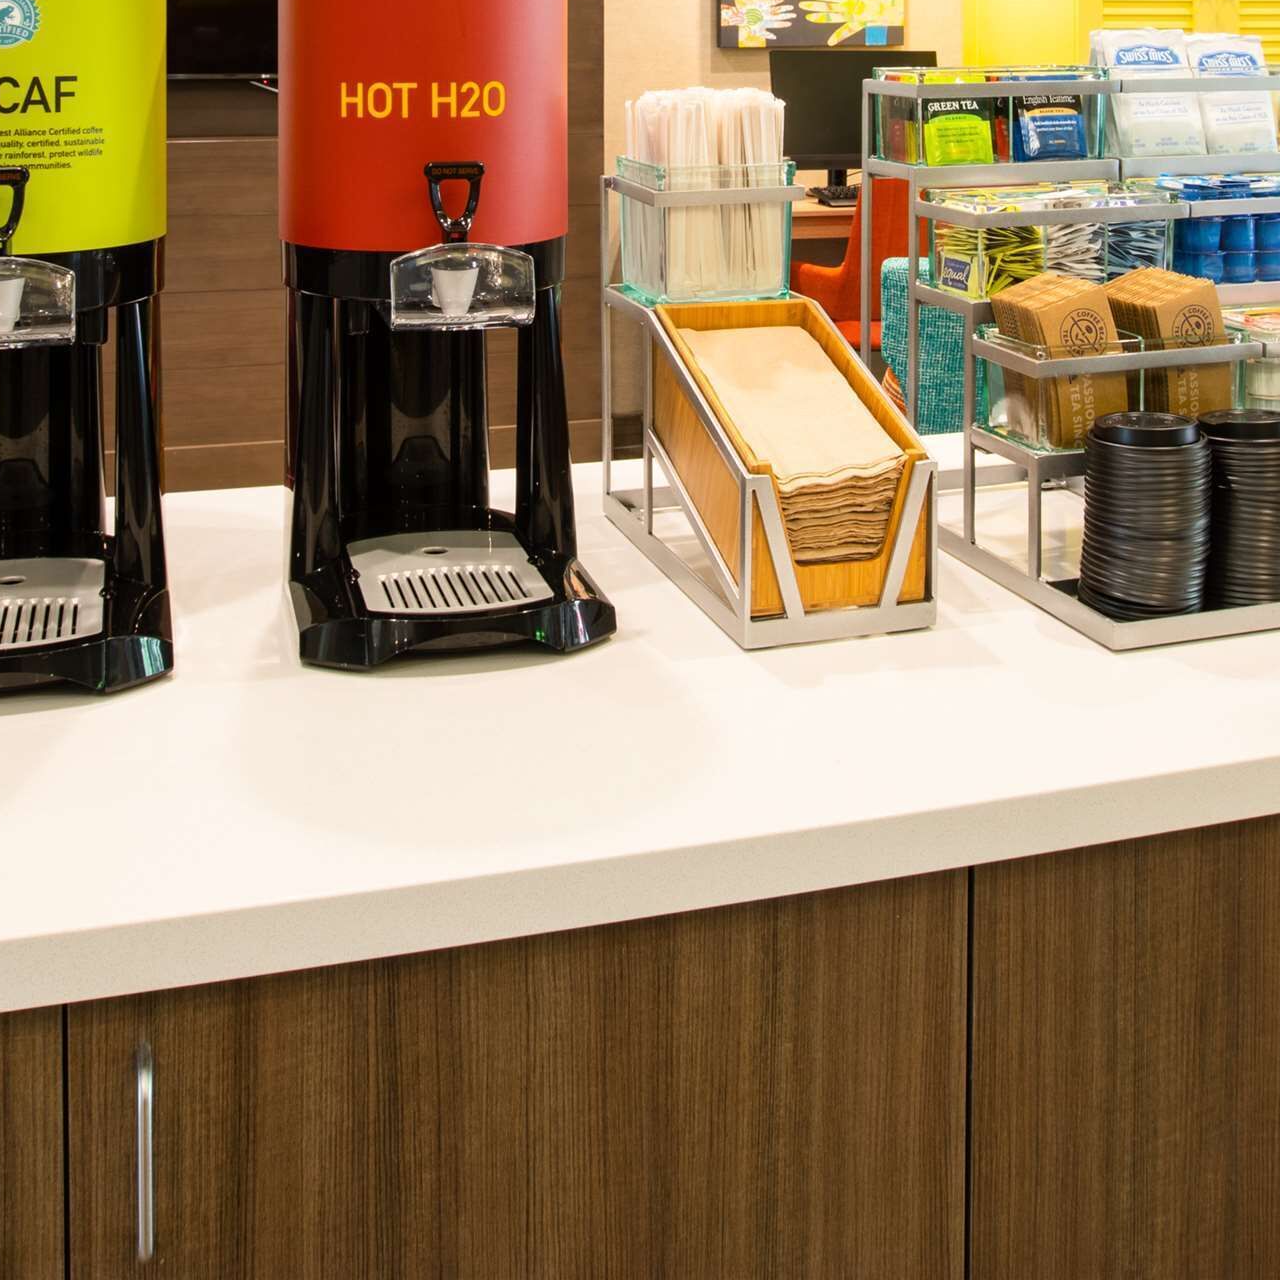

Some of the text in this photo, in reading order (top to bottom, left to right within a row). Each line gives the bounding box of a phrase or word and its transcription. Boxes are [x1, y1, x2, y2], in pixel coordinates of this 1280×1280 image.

[340, 82, 418, 118] HOT
[928, 100, 979, 112] GREEN TEA
[14, 128, 46, 136] Alliance
[48, 127, 81, 136] Certified
[82, 126, 104, 134] coffee
[63, 137, 105, 146] sustainable
[49, 150, 76, 160] protect
[78, 148, 102, 157] wildlife
[943, 265, 969, 285] equal
[1077, 311, 1101, 324] COFFEE
[1188, 308, 1209, 320] COFFEE
[1070, 384, 1081, 412] TEA
